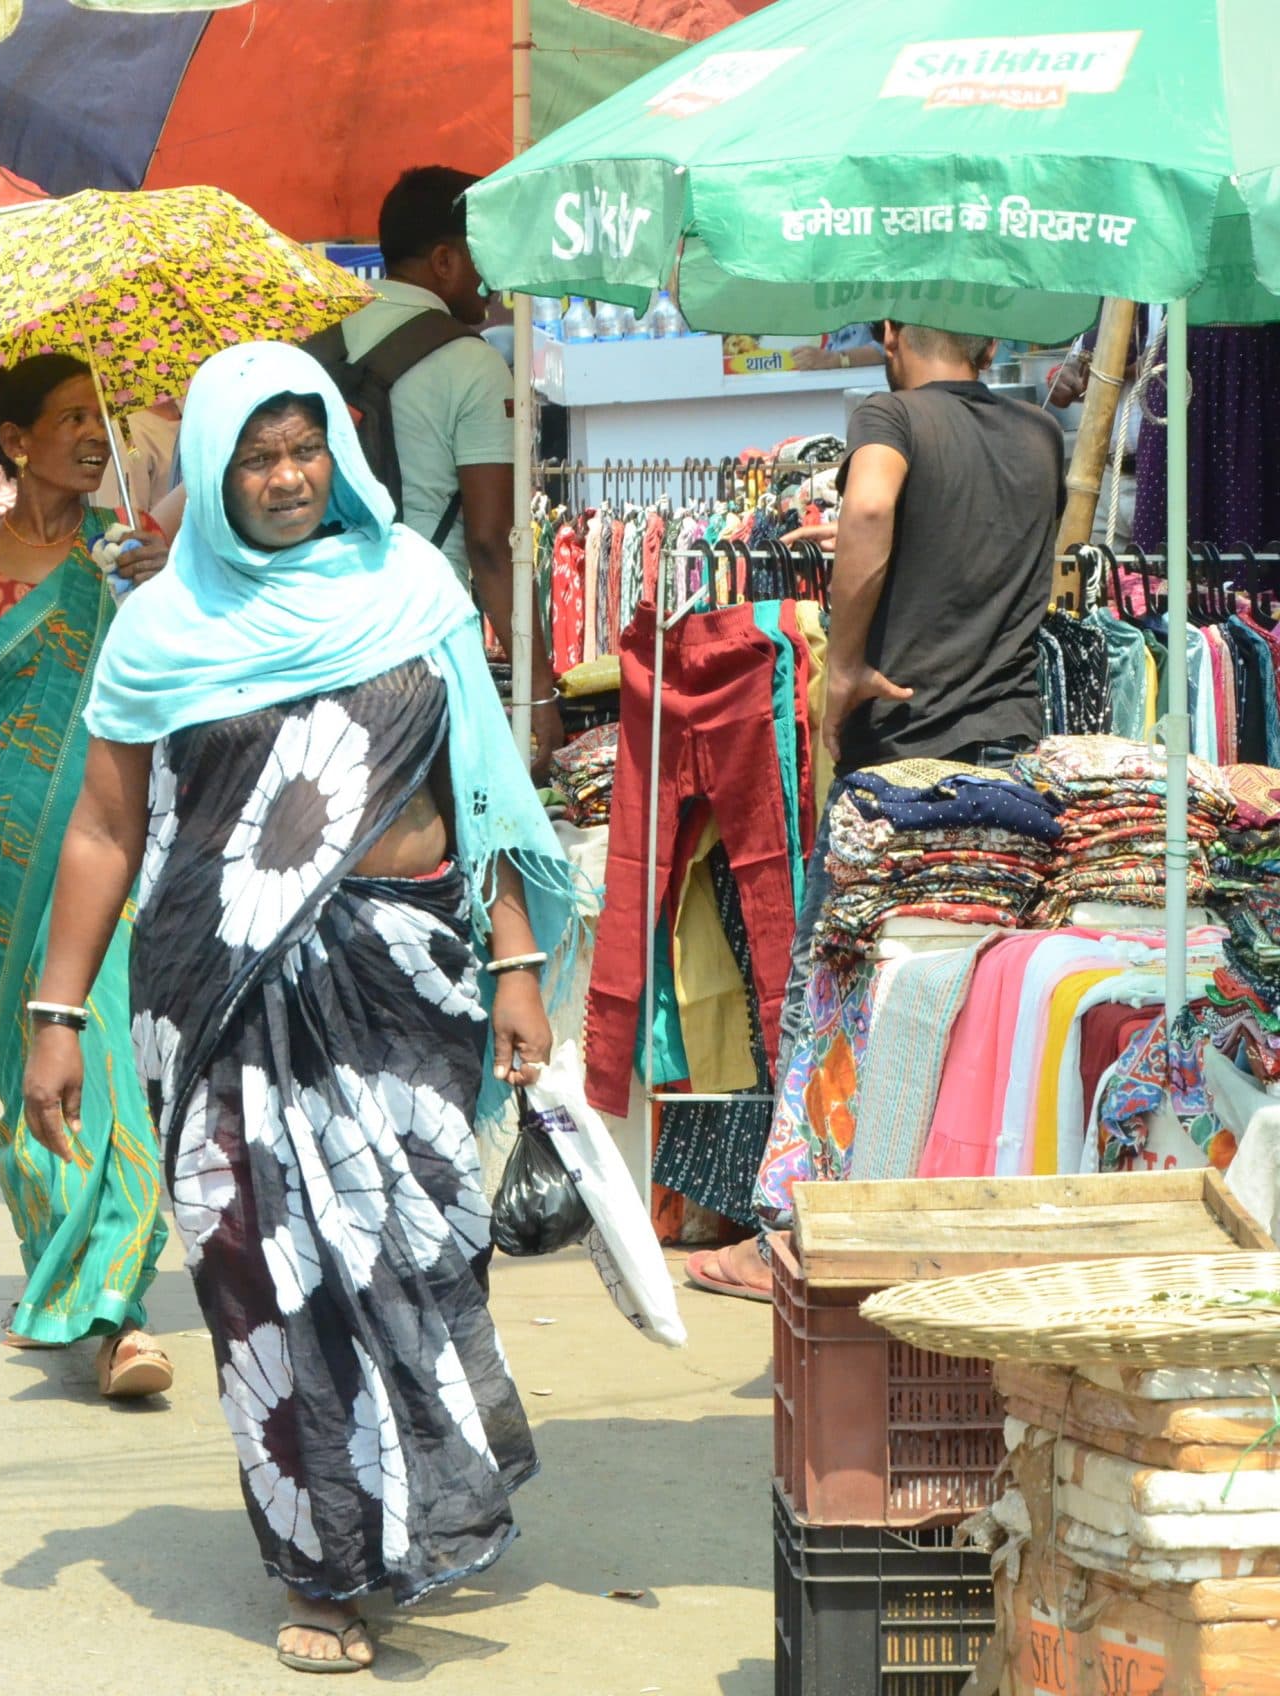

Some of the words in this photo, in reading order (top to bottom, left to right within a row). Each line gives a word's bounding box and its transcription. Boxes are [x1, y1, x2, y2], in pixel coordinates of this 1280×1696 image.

[906, 48, 1098, 79] Shikhar
[780, 197, 875, 241] हमेशा
[880, 204, 955, 236] स्वाद
[959, 194, 993, 232] के
[998, 194, 1096, 243] शिखर
[1097, 212, 1137, 247] पर
[746, 352, 782, 371] थाली
